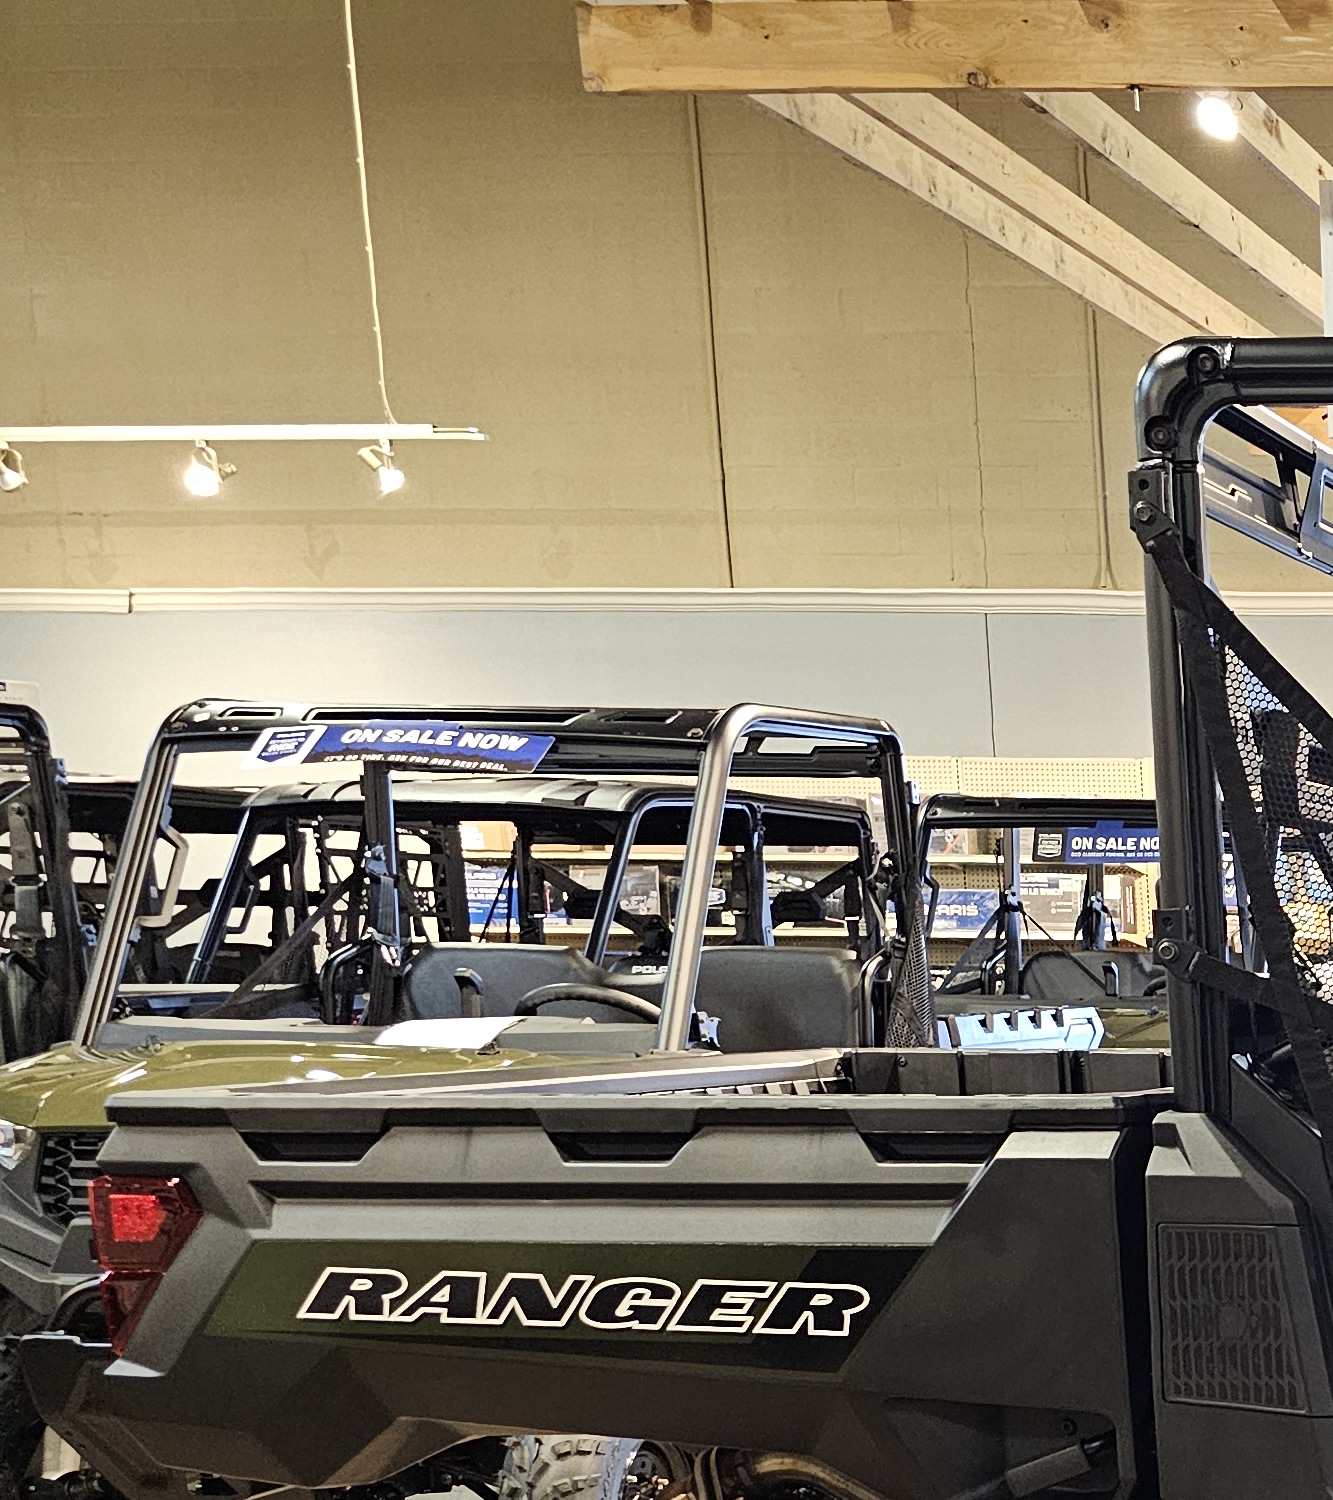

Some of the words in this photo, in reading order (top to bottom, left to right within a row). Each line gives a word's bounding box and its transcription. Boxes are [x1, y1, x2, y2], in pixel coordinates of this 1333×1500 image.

[340, 729, 383, 744] ON
[382, 730, 459, 746] SALE
[457, 732, 529, 751] NOW
[1071, 836, 1094, 850] ON
[1095, 837, 1138, 851] SALE
[1139, 836, 1160, 850] NO
[631, 965, 669, 974] POLA
[298, 1266, 870, 1336] RANGER
